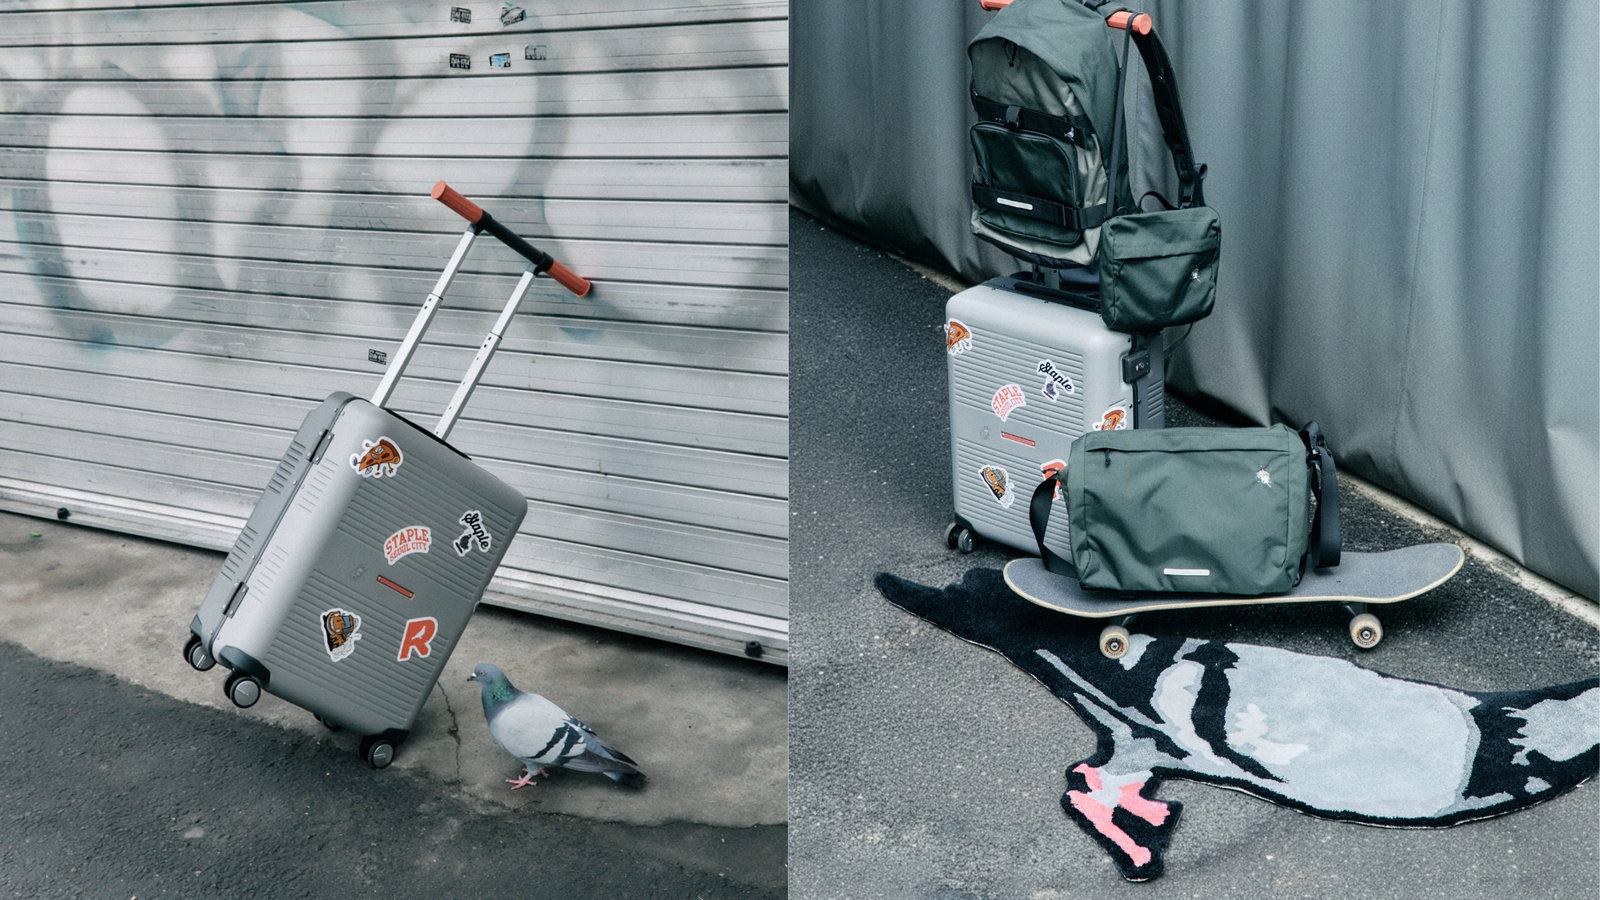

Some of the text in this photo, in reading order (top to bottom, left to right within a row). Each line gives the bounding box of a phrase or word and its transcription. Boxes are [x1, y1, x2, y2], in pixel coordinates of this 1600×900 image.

[1038, 361, 1072, 391] Staple
[993, 385, 1022, 414] STAPLE
[1010, 397, 1023, 406] CITY
[385, 528, 429, 555] STAPLE
[461, 513, 489, 549] Staple
[411, 542, 427, 551] CITY
[400, 619, 436, 660] R
